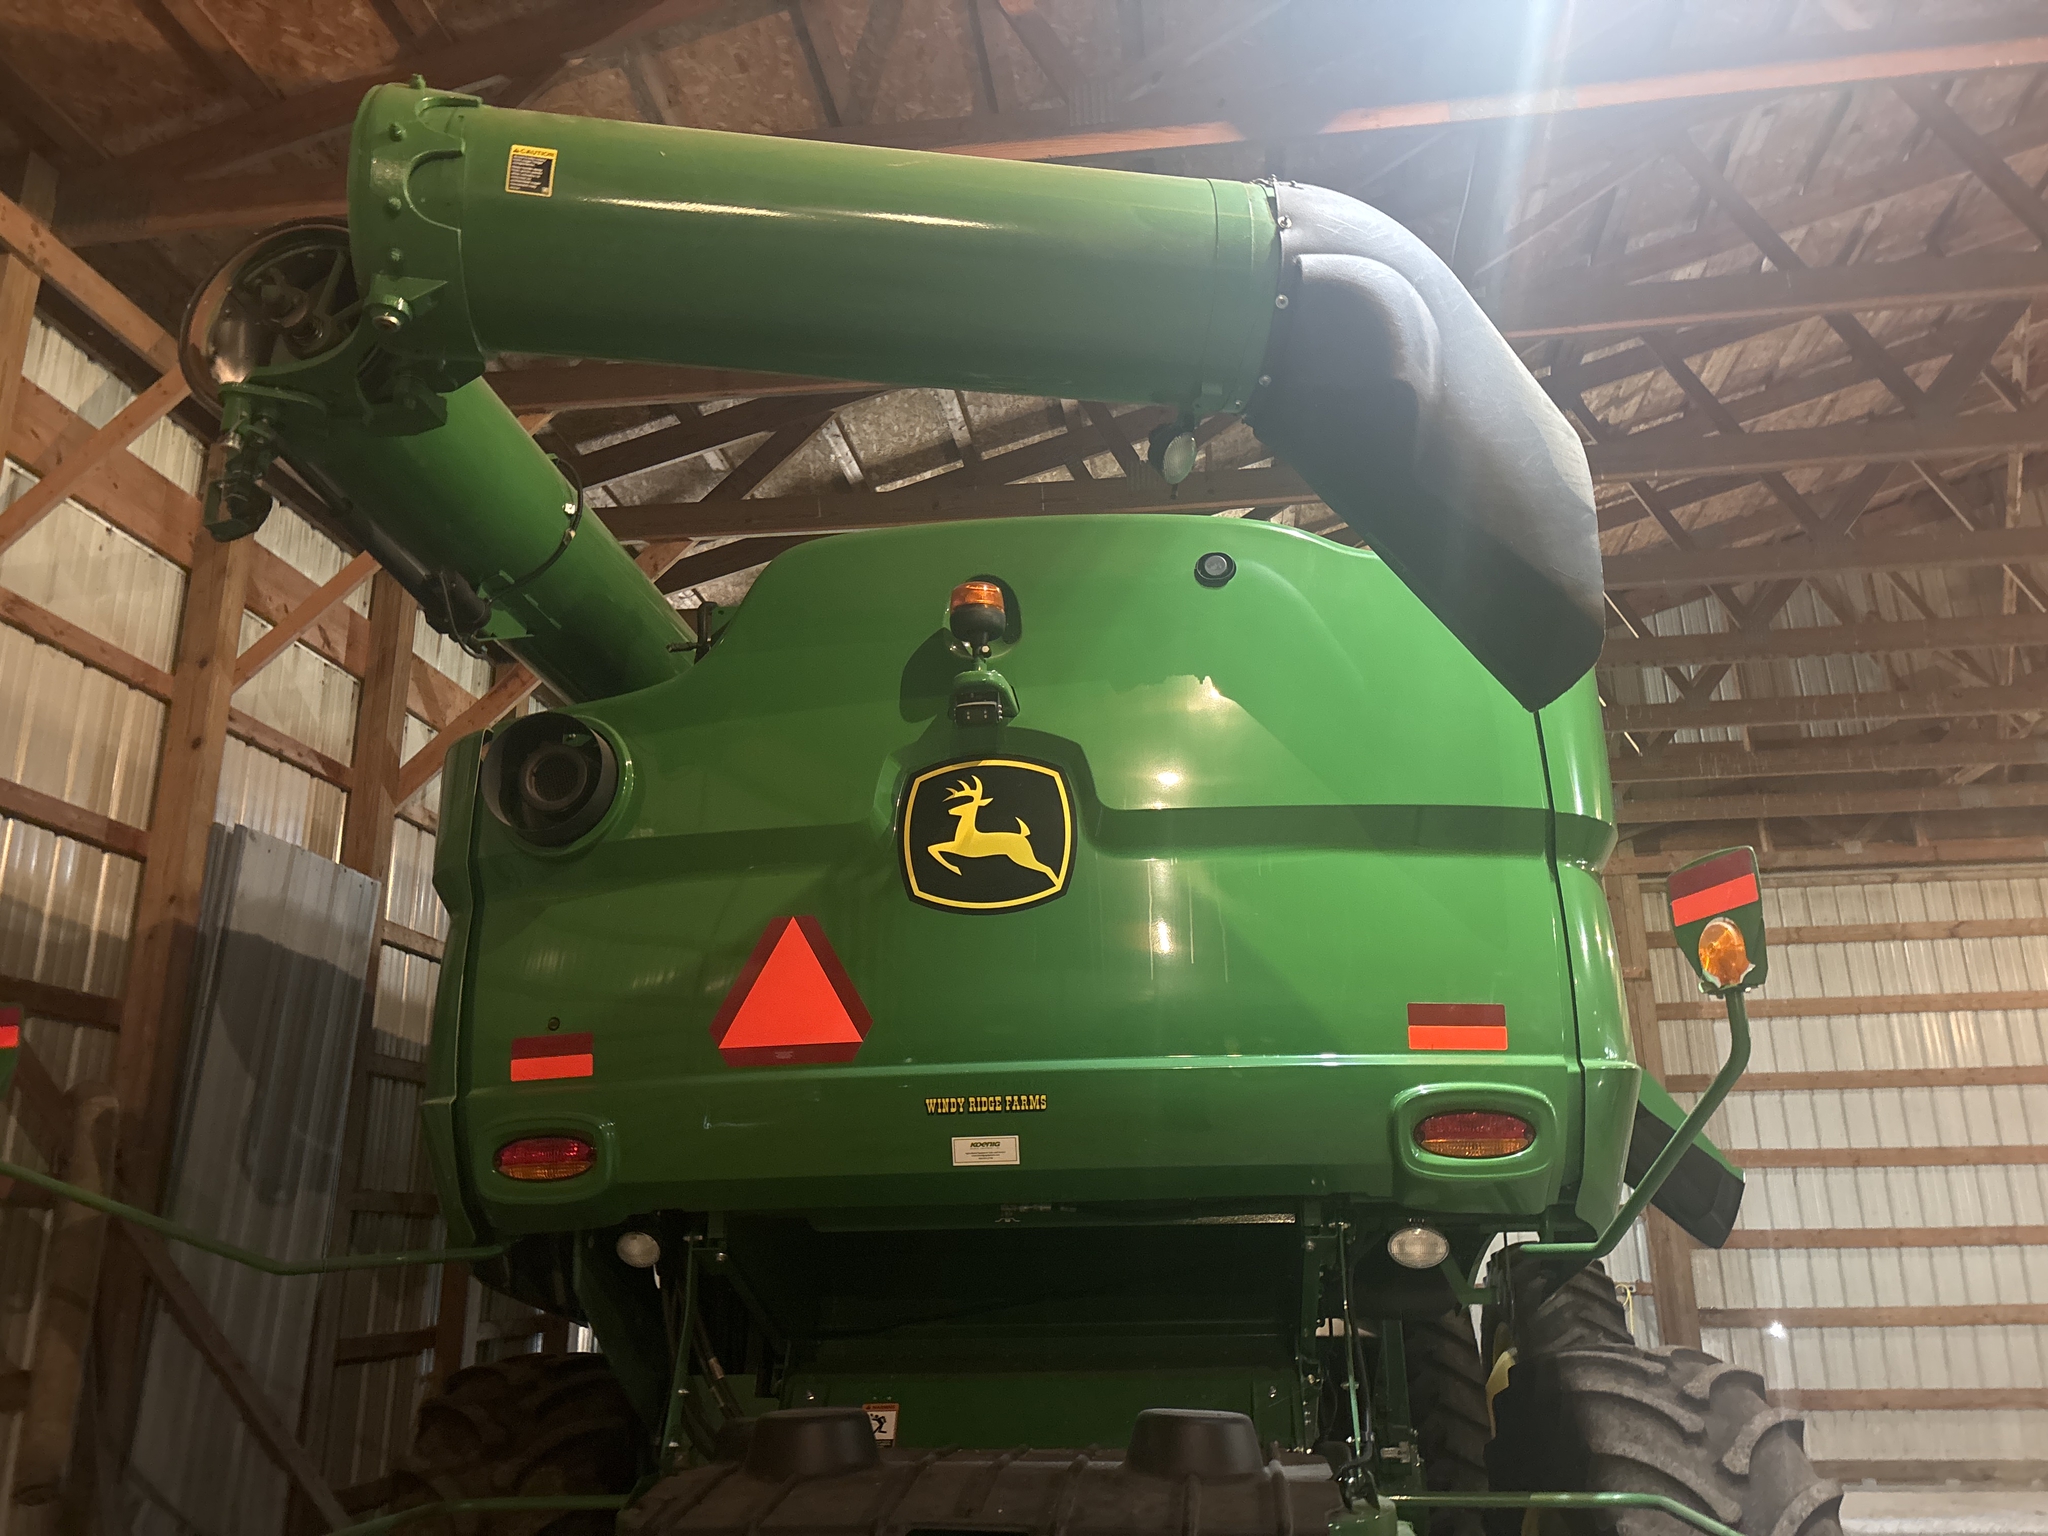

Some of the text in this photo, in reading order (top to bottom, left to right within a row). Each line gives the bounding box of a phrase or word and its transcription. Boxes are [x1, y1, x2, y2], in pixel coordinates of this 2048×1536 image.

[925, 1094, 1047, 1114] WINDY RIDGE FARMS
